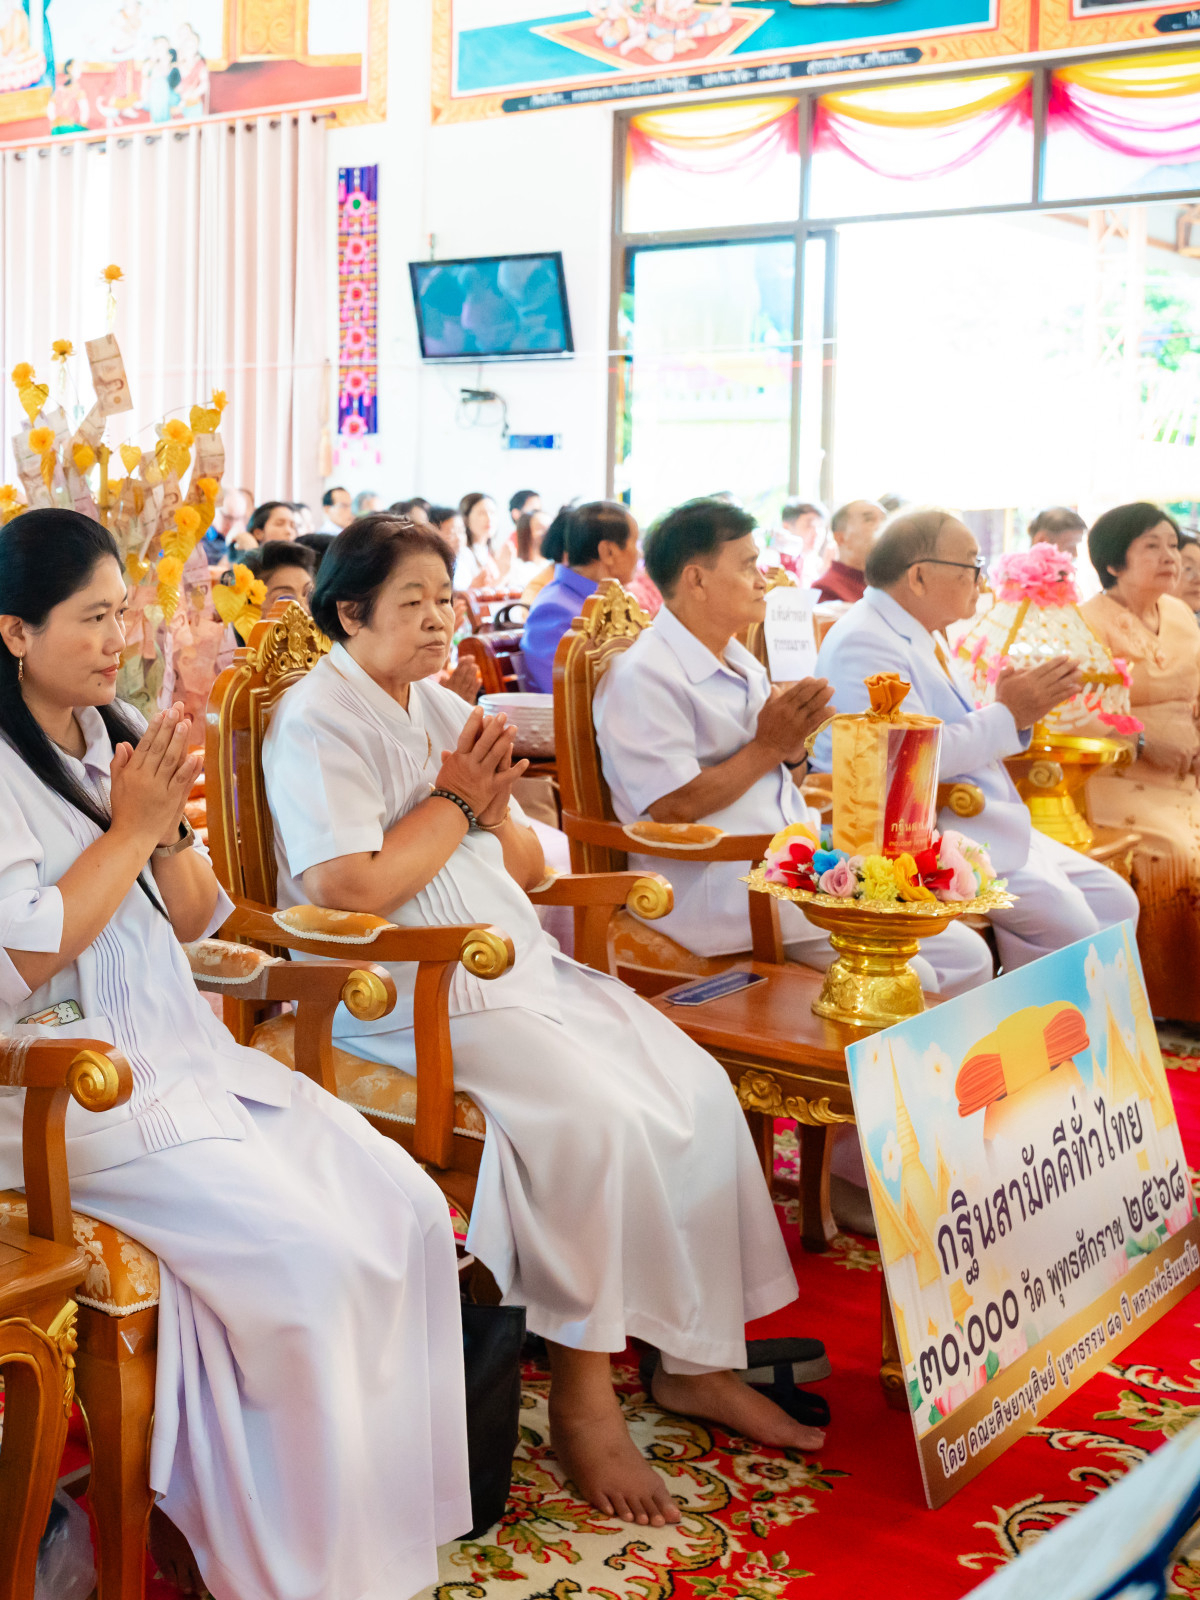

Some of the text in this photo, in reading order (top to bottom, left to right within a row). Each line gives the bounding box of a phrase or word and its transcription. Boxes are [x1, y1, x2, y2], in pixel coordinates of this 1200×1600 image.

[919, 1159, 1186, 1395] ๓๐,๐๐๐ วัด พุทธศักราช ๒๕๖๘
[937, 1095, 1143, 1286] กฐินสามัคคีทั่วไทย
[938, 1438, 966, 1475] โดย
[968, 1355, 1056, 1453] คณะศิษยานุศิษย์
[1058, 1326, 1106, 1385] บูชาธรรม
[1120, 1293, 1132, 1323] ปี
